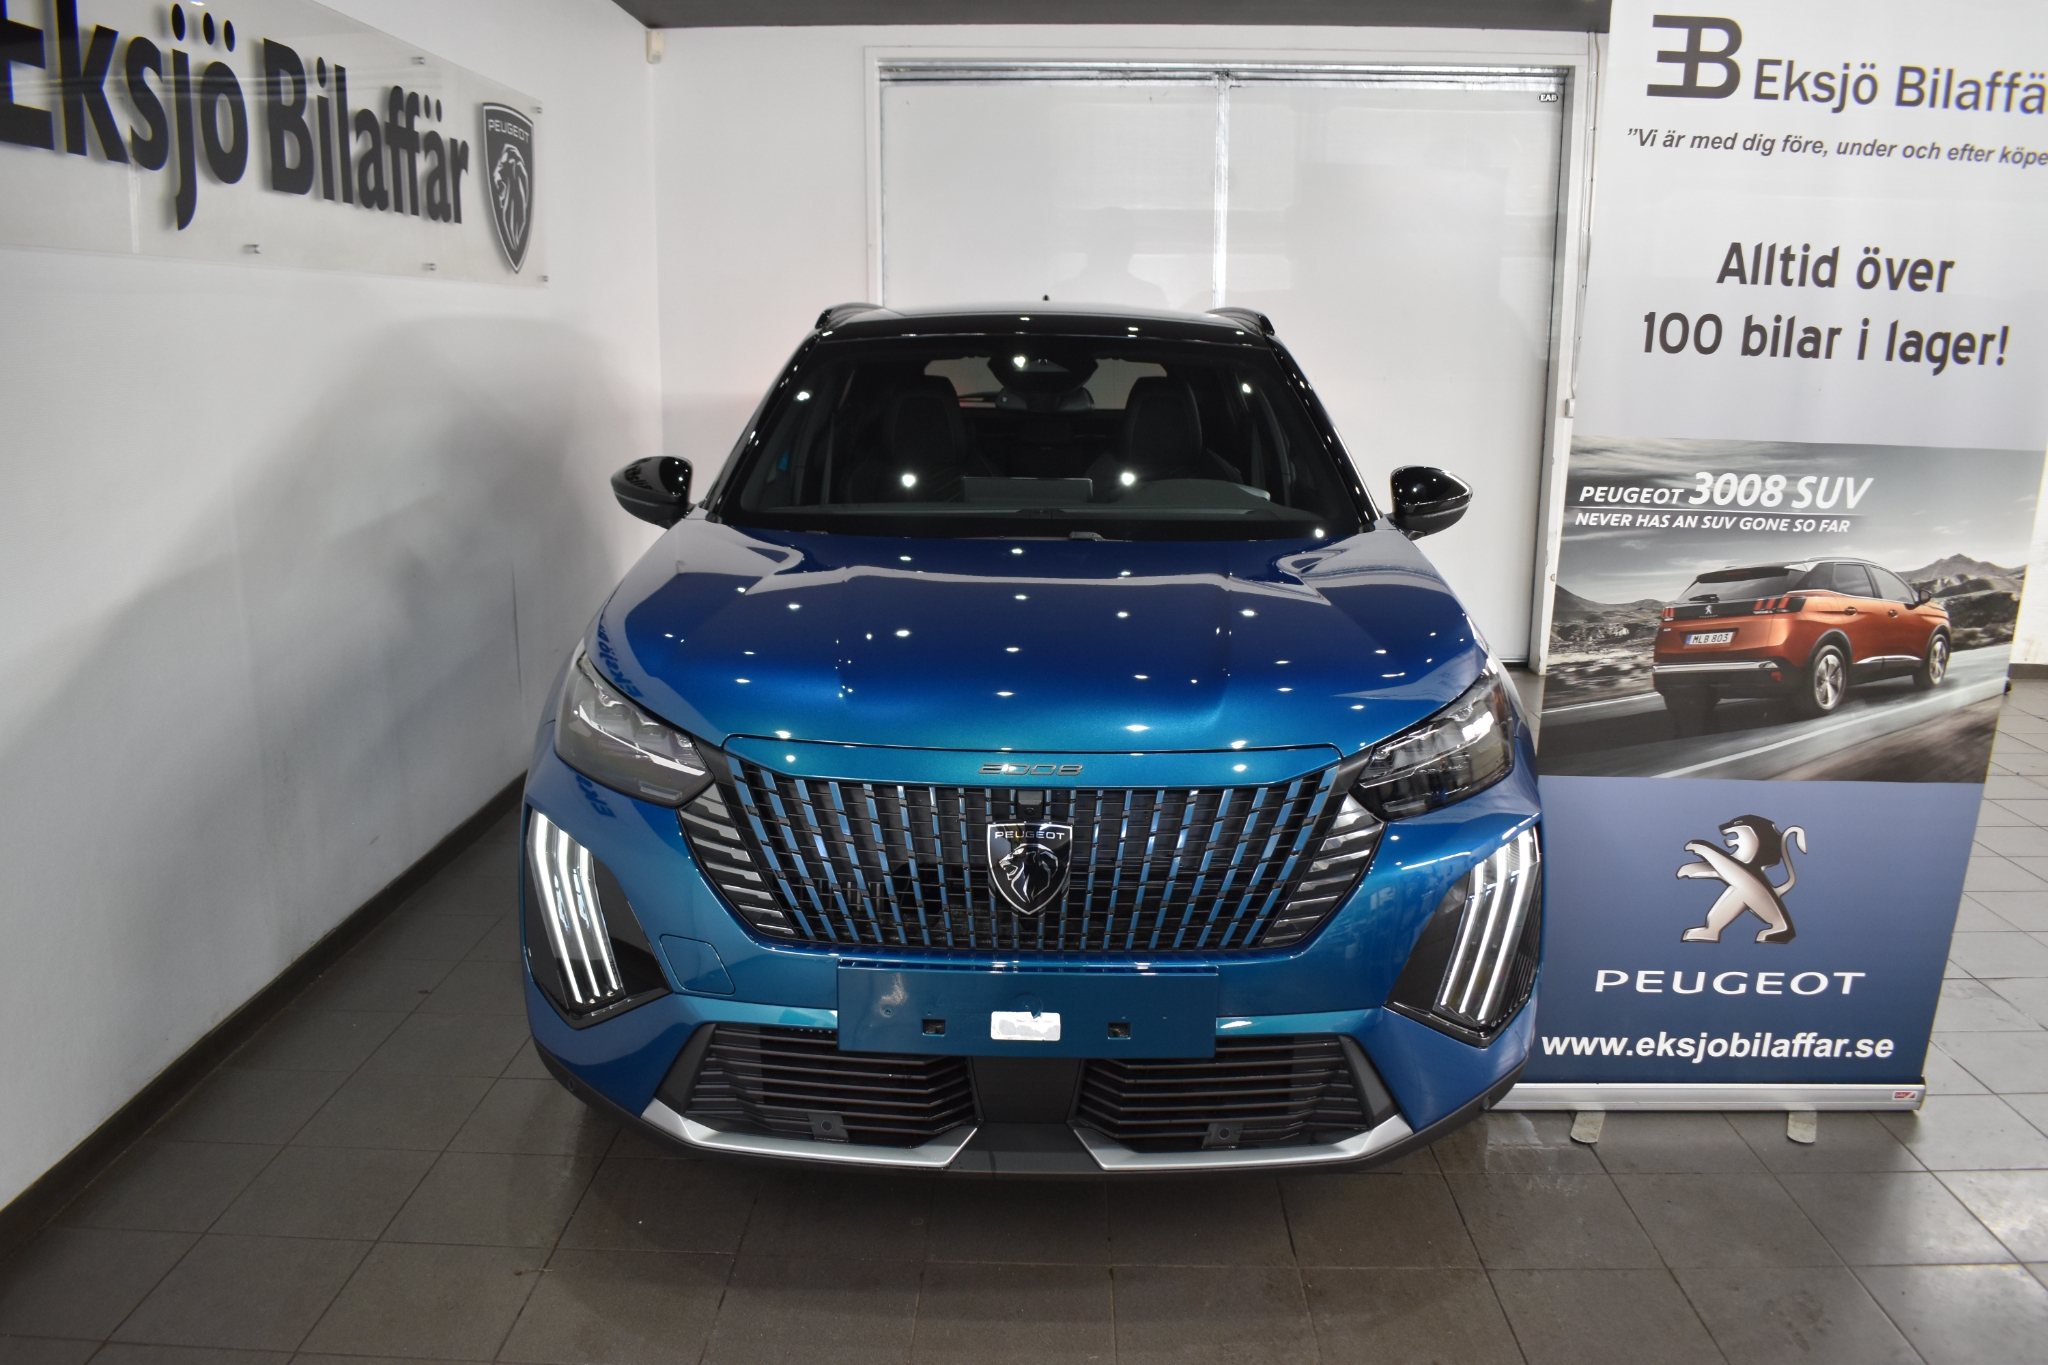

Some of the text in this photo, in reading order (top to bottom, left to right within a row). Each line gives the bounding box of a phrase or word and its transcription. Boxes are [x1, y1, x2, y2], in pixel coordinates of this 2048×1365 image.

[1540, 94, 1557, 102] EAB
[1753, 58, 1879, 114] Eksjö
[263, 37, 470, 224] Bilaffär
[488, 118, 530, 143] PEUGEOT
[1662, 130, 1686, 148] är
[1689, 132, 1739, 150] med
[1742, 133, 1776, 157] dig
[1781, 134, 1829, 158] före,
[1836, 138, 1898, 158] under
[1902, 142, 1943, 160] och
[1947, 143, 1996, 163] efter
[1715, 242, 1956, 293] Alltid över
[1643, 311, 2010, 377] 100 bilar i lager!
[1579, 471, 1874, 509] PEUGEOT 3008 SUV
[1575, 512, 1851, 533] NEVER HAS AN SUV GONE SO FAR
[979, 763, 1084, 776] 2008
[995, 830, 1066, 840] PEUGEOT
[1594, 969, 1867, 996] PEUGEOT
[1541, 1031, 1895, 1064] www.eksjobilaffar.se
